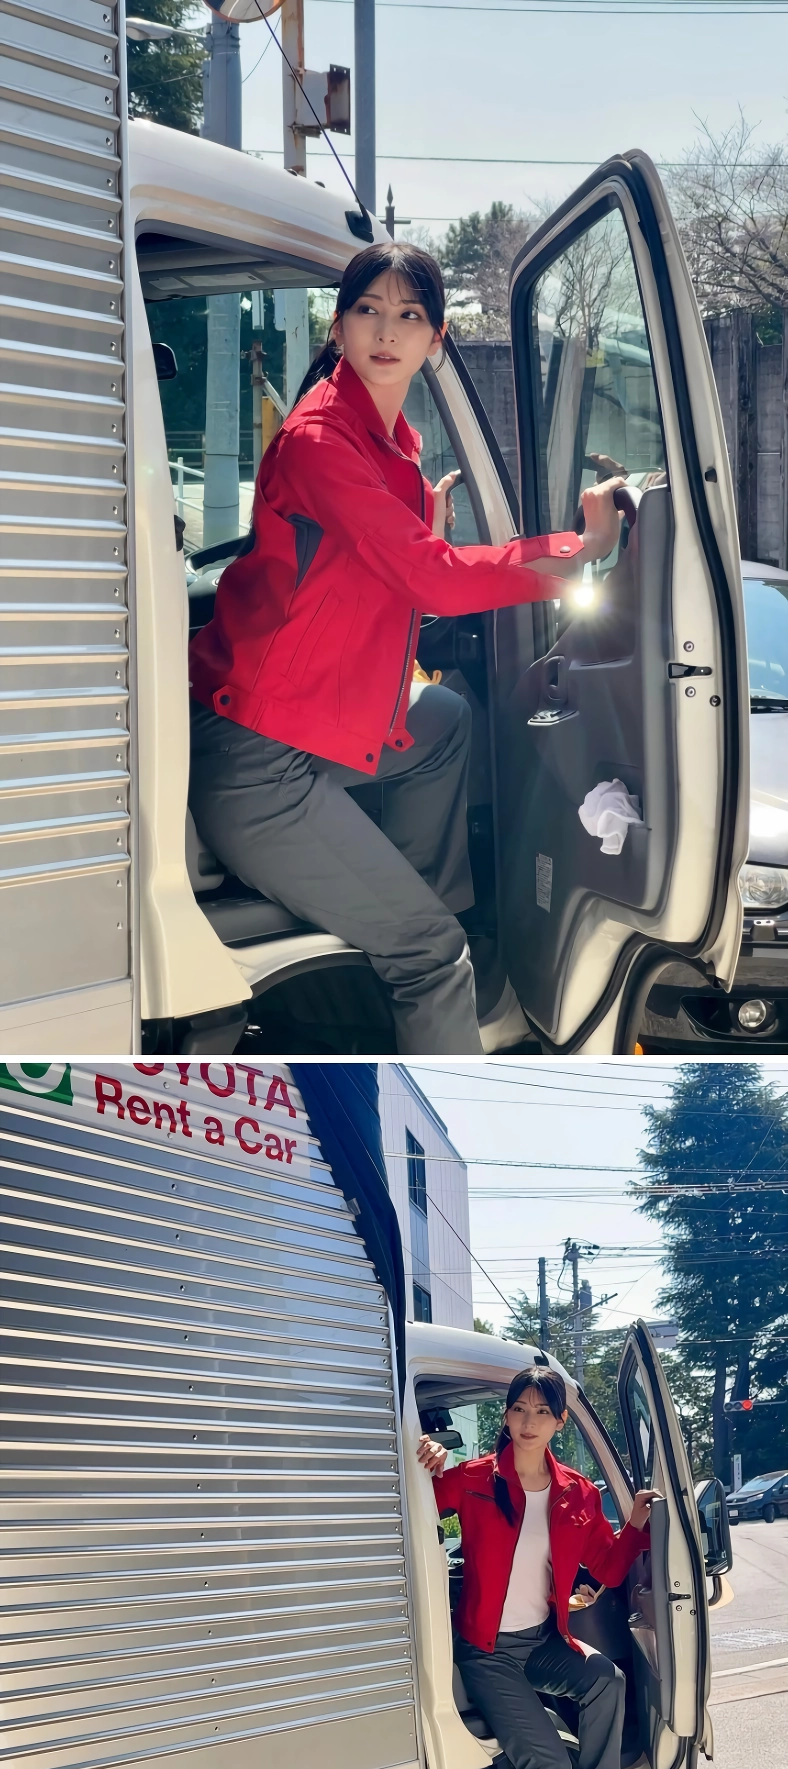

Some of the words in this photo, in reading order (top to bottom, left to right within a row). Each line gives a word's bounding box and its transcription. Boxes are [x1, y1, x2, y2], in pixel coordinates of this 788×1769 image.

[95, 1074, 192, 1137] Rent
[204, 1116, 225, 1146] a
[235, 1116, 297, 1164] Car
